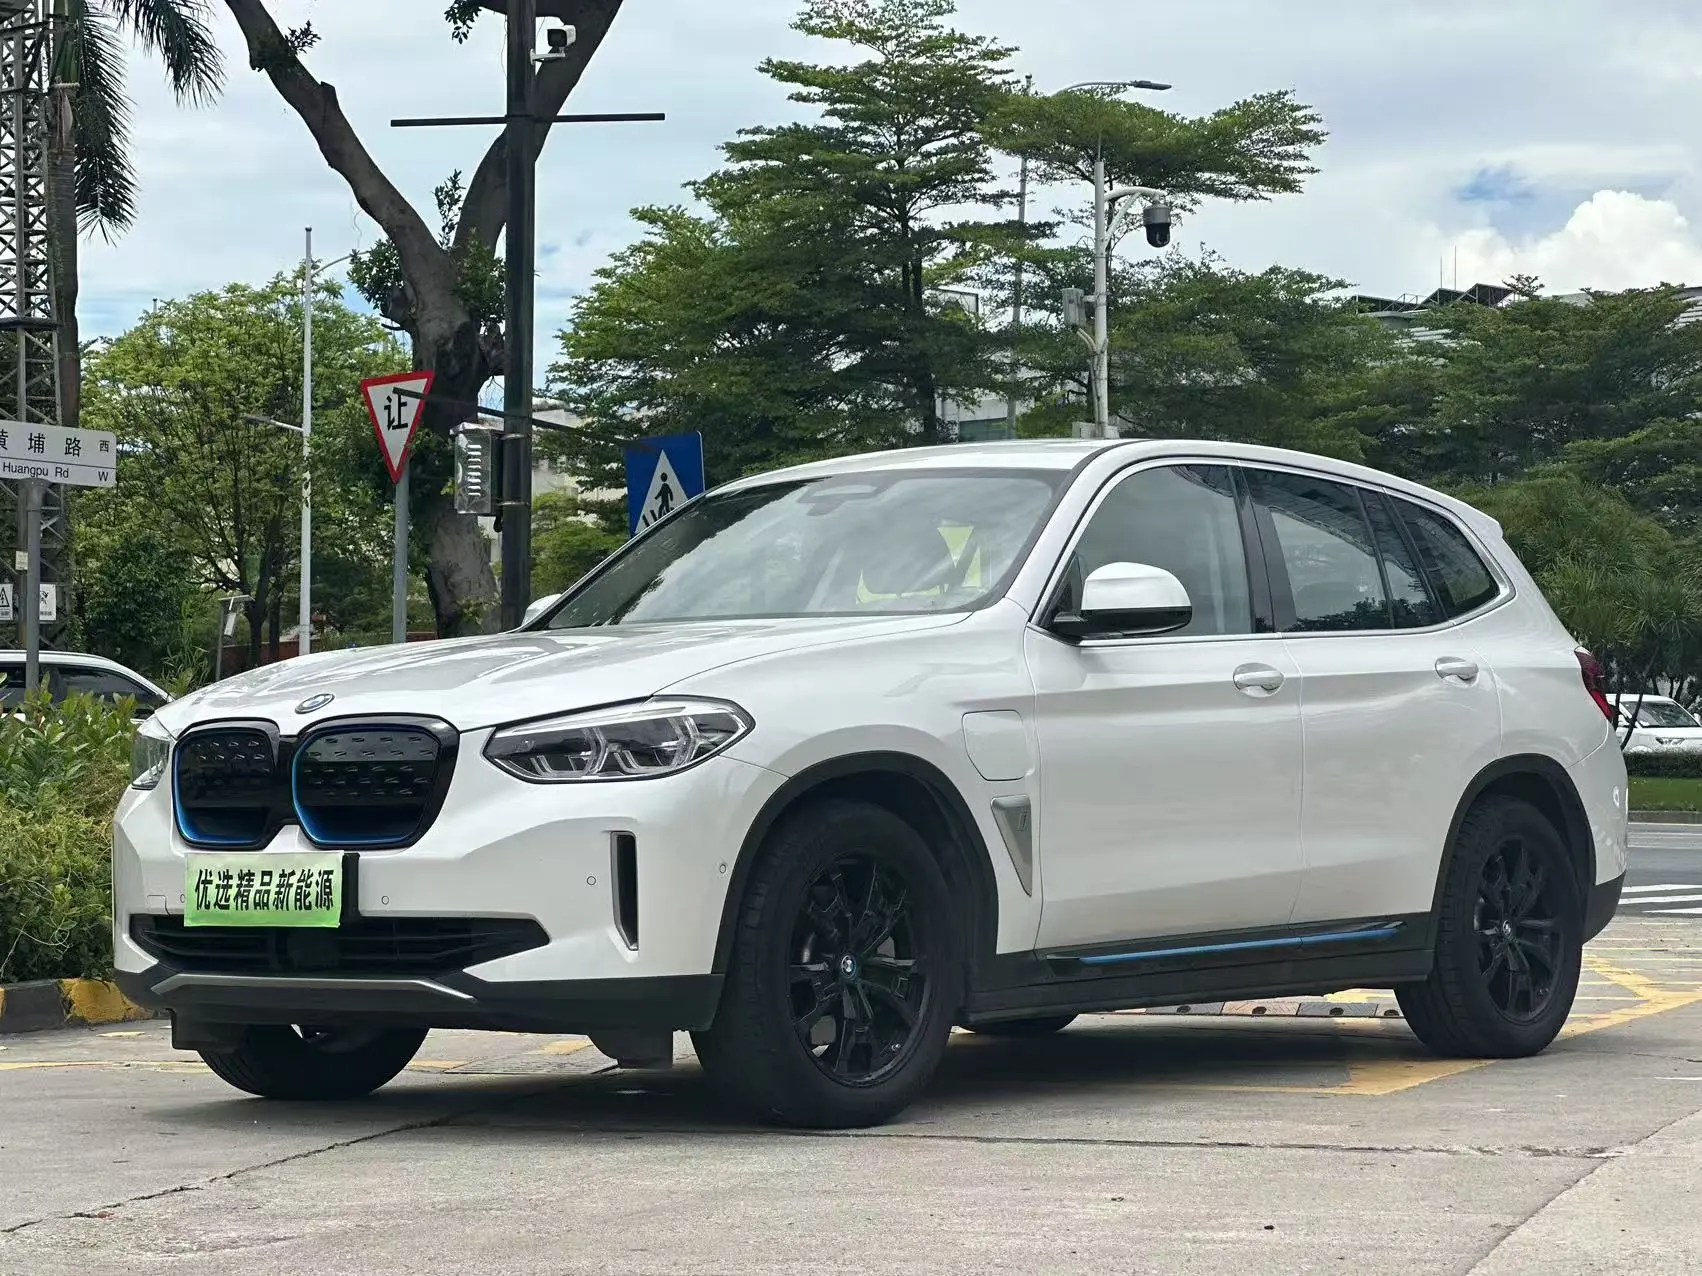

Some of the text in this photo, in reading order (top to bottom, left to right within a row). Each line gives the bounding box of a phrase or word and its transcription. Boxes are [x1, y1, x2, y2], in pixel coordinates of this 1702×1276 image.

[384, 387, 409, 431] 让
[99, 440, 110, 453] 西
[3, 462, 109, 482] Huangpu Rd W
[194, 868, 335, 911] 优选精品新能源
